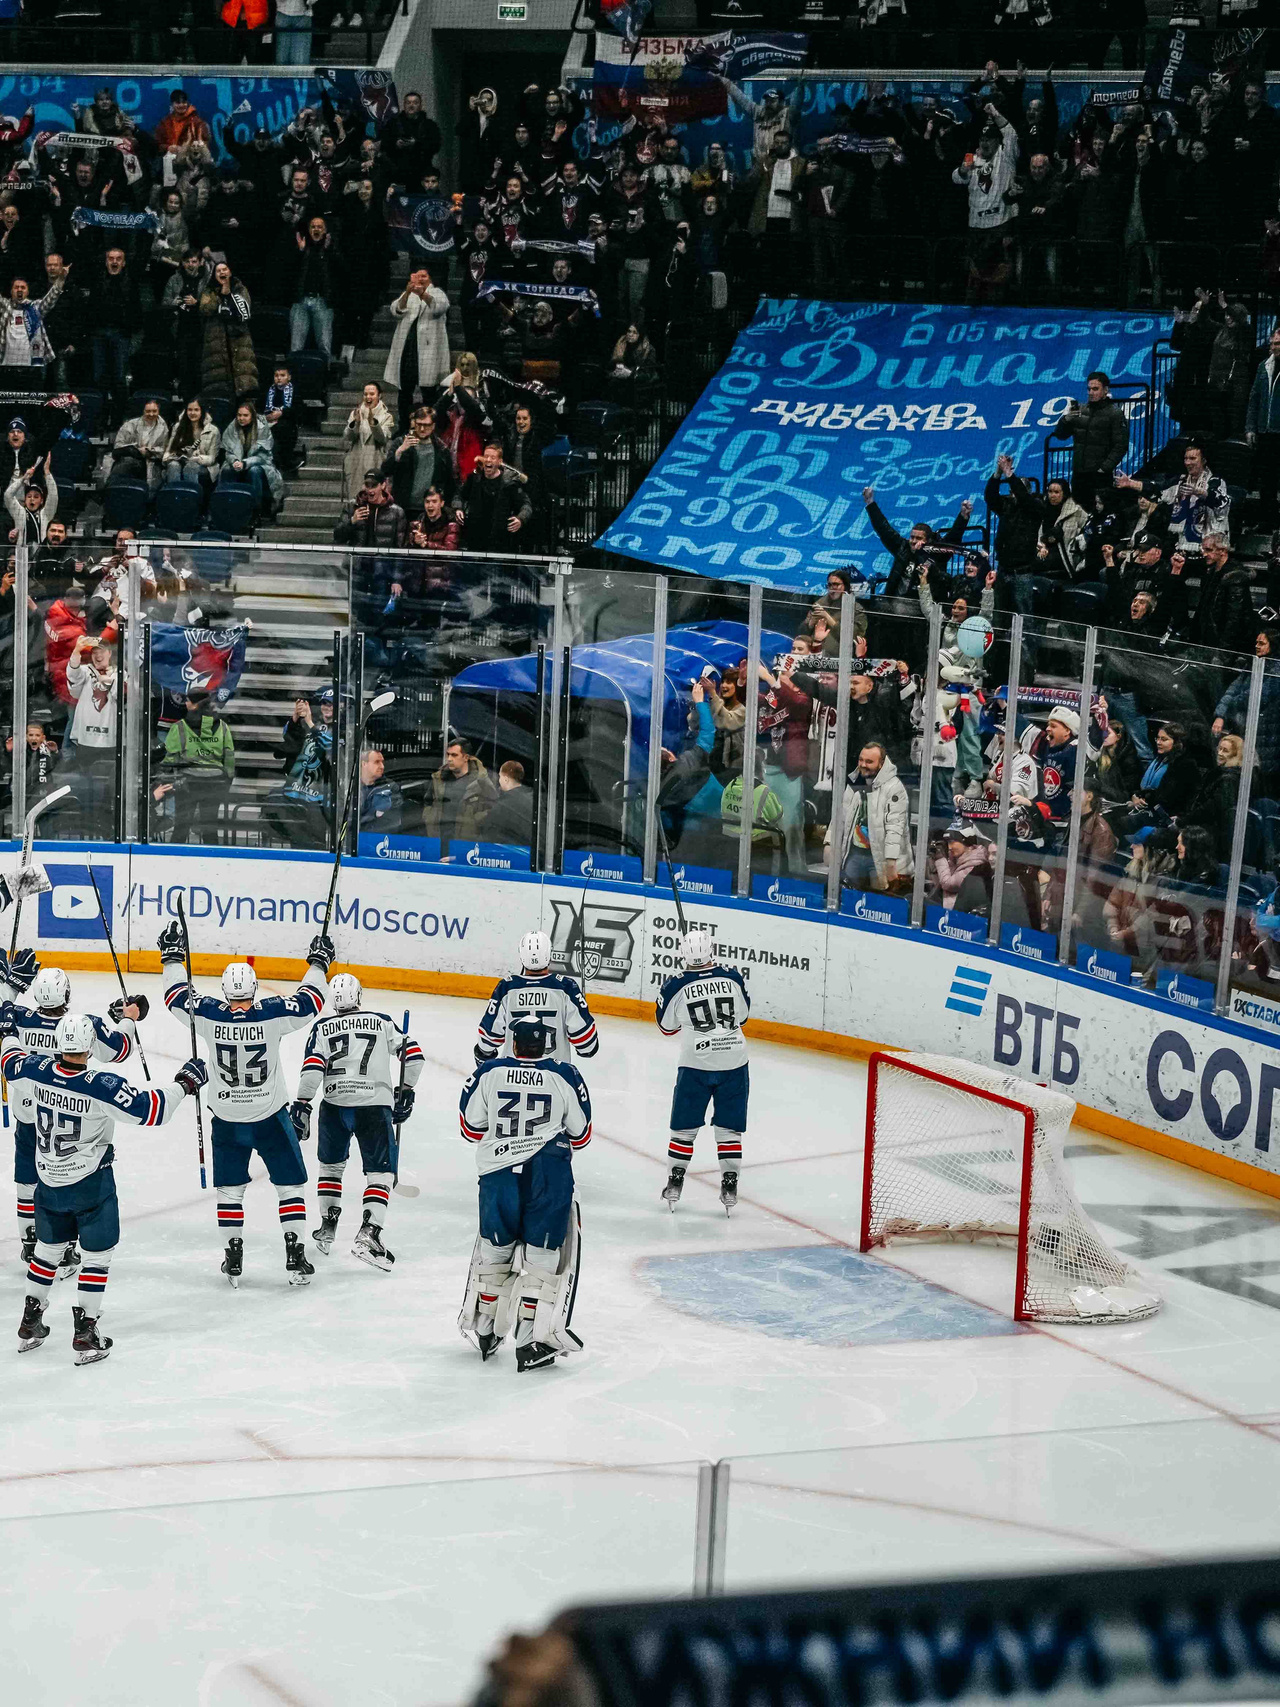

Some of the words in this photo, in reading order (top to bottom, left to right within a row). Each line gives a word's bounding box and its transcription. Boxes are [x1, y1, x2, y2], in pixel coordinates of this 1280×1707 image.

[525, 284, 575, 296] ТОРПЕДО
[724, 793, 743, 803] STEW
[726, 803, 742, 814] 40
[388, 850, 421, 861] ГАЗПРОМ
[479, 857, 511, 869] ГАЗПРОМ
[683, 880, 714, 893] ГАЗПРОМ
[777, 893, 807, 907] ГАЗПРОМ
[121, 883, 470, 940] /HCDynamoMoscow
[865, 908, 892, 924] ГАЗПРОМ
[947, 926, 972, 941] ГАЗПРОМ
[1020, 943, 1042, 959] ГАЗПРОМ
[552, 952, 567, 961] 022
[606, 959, 625, 968] 2023
[1095, 963, 1118, 981] ГАЗПРОМ
[684, 981, 733, 1000] VERYAYEV
[1175, 989, 1199, 1007] ГАЗПРОМ
[518, 992, 548, 1006] SIZOV
[214, 1025, 264, 1041] BELEVICH
[321, 1019, 383, 1037] GONCHARUK
[24, 1031, 59, 1049] VORON
[994, 993, 1081, 1086] ВТБ
[326, 1032, 378, 1077] 27
[215, 1042, 269, 1088] 93
[506, 1070, 544, 1087] HUSKA
[494, 1090, 552, 1140] 32
[36, 1104, 83, 1158] 92
